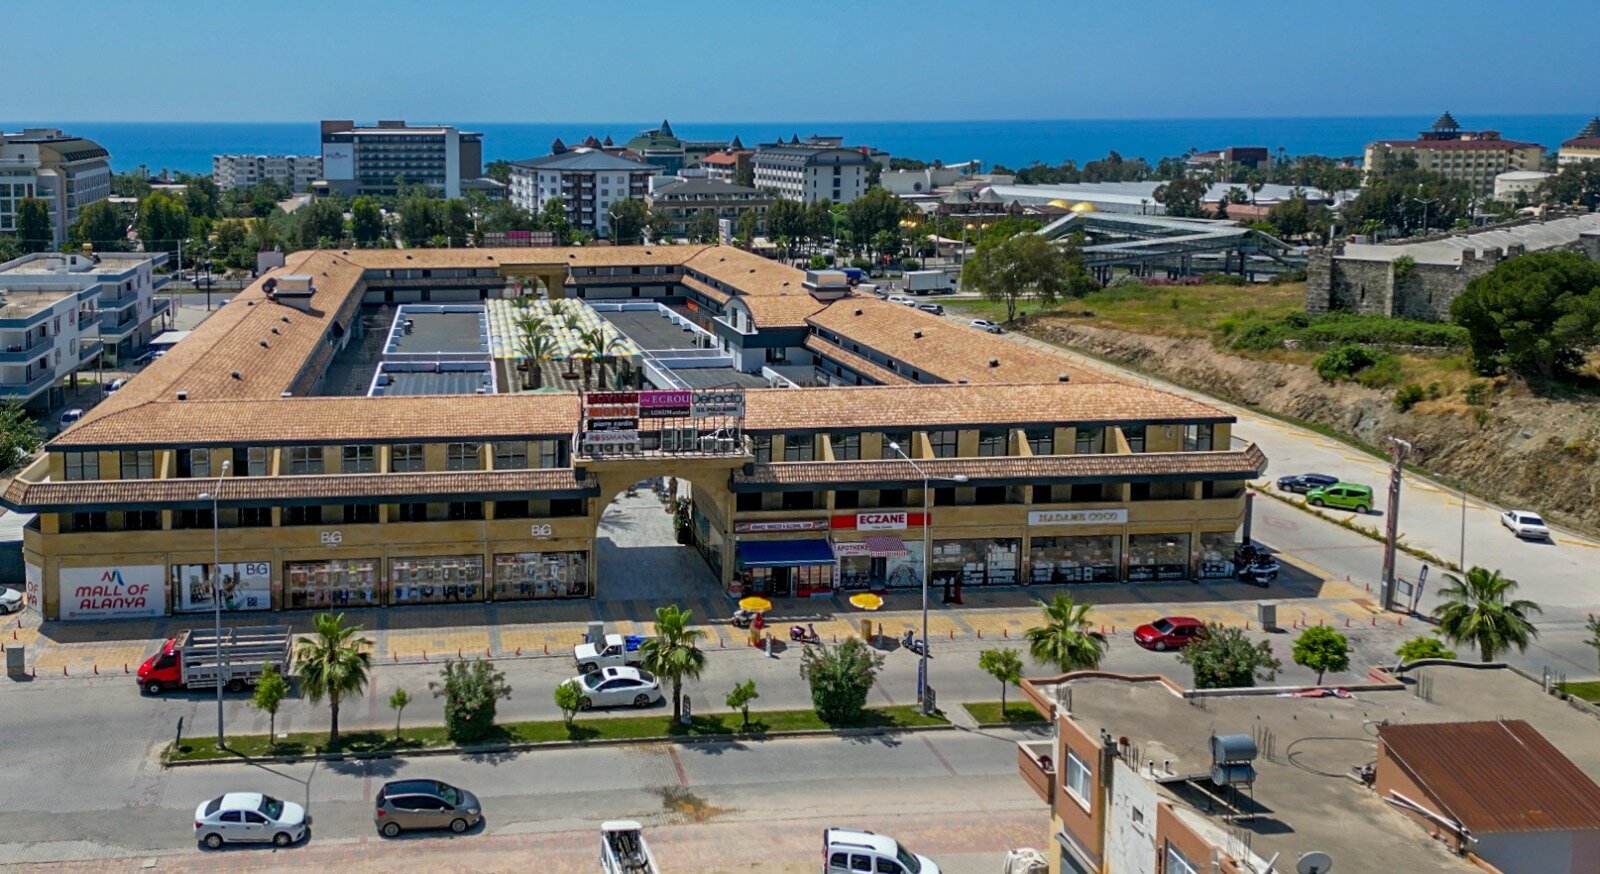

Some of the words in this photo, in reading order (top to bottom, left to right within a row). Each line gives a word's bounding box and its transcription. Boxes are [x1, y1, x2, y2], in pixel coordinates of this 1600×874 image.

[692, 393, 742, 404] DeFacto
[588, 407, 638, 416] MIGROS
[860, 514, 905, 524] ECZANE
[75, 585, 122, 597] MALL
[127, 584, 150, 595] OF
[80, 597, 146, 610] ALANYA
